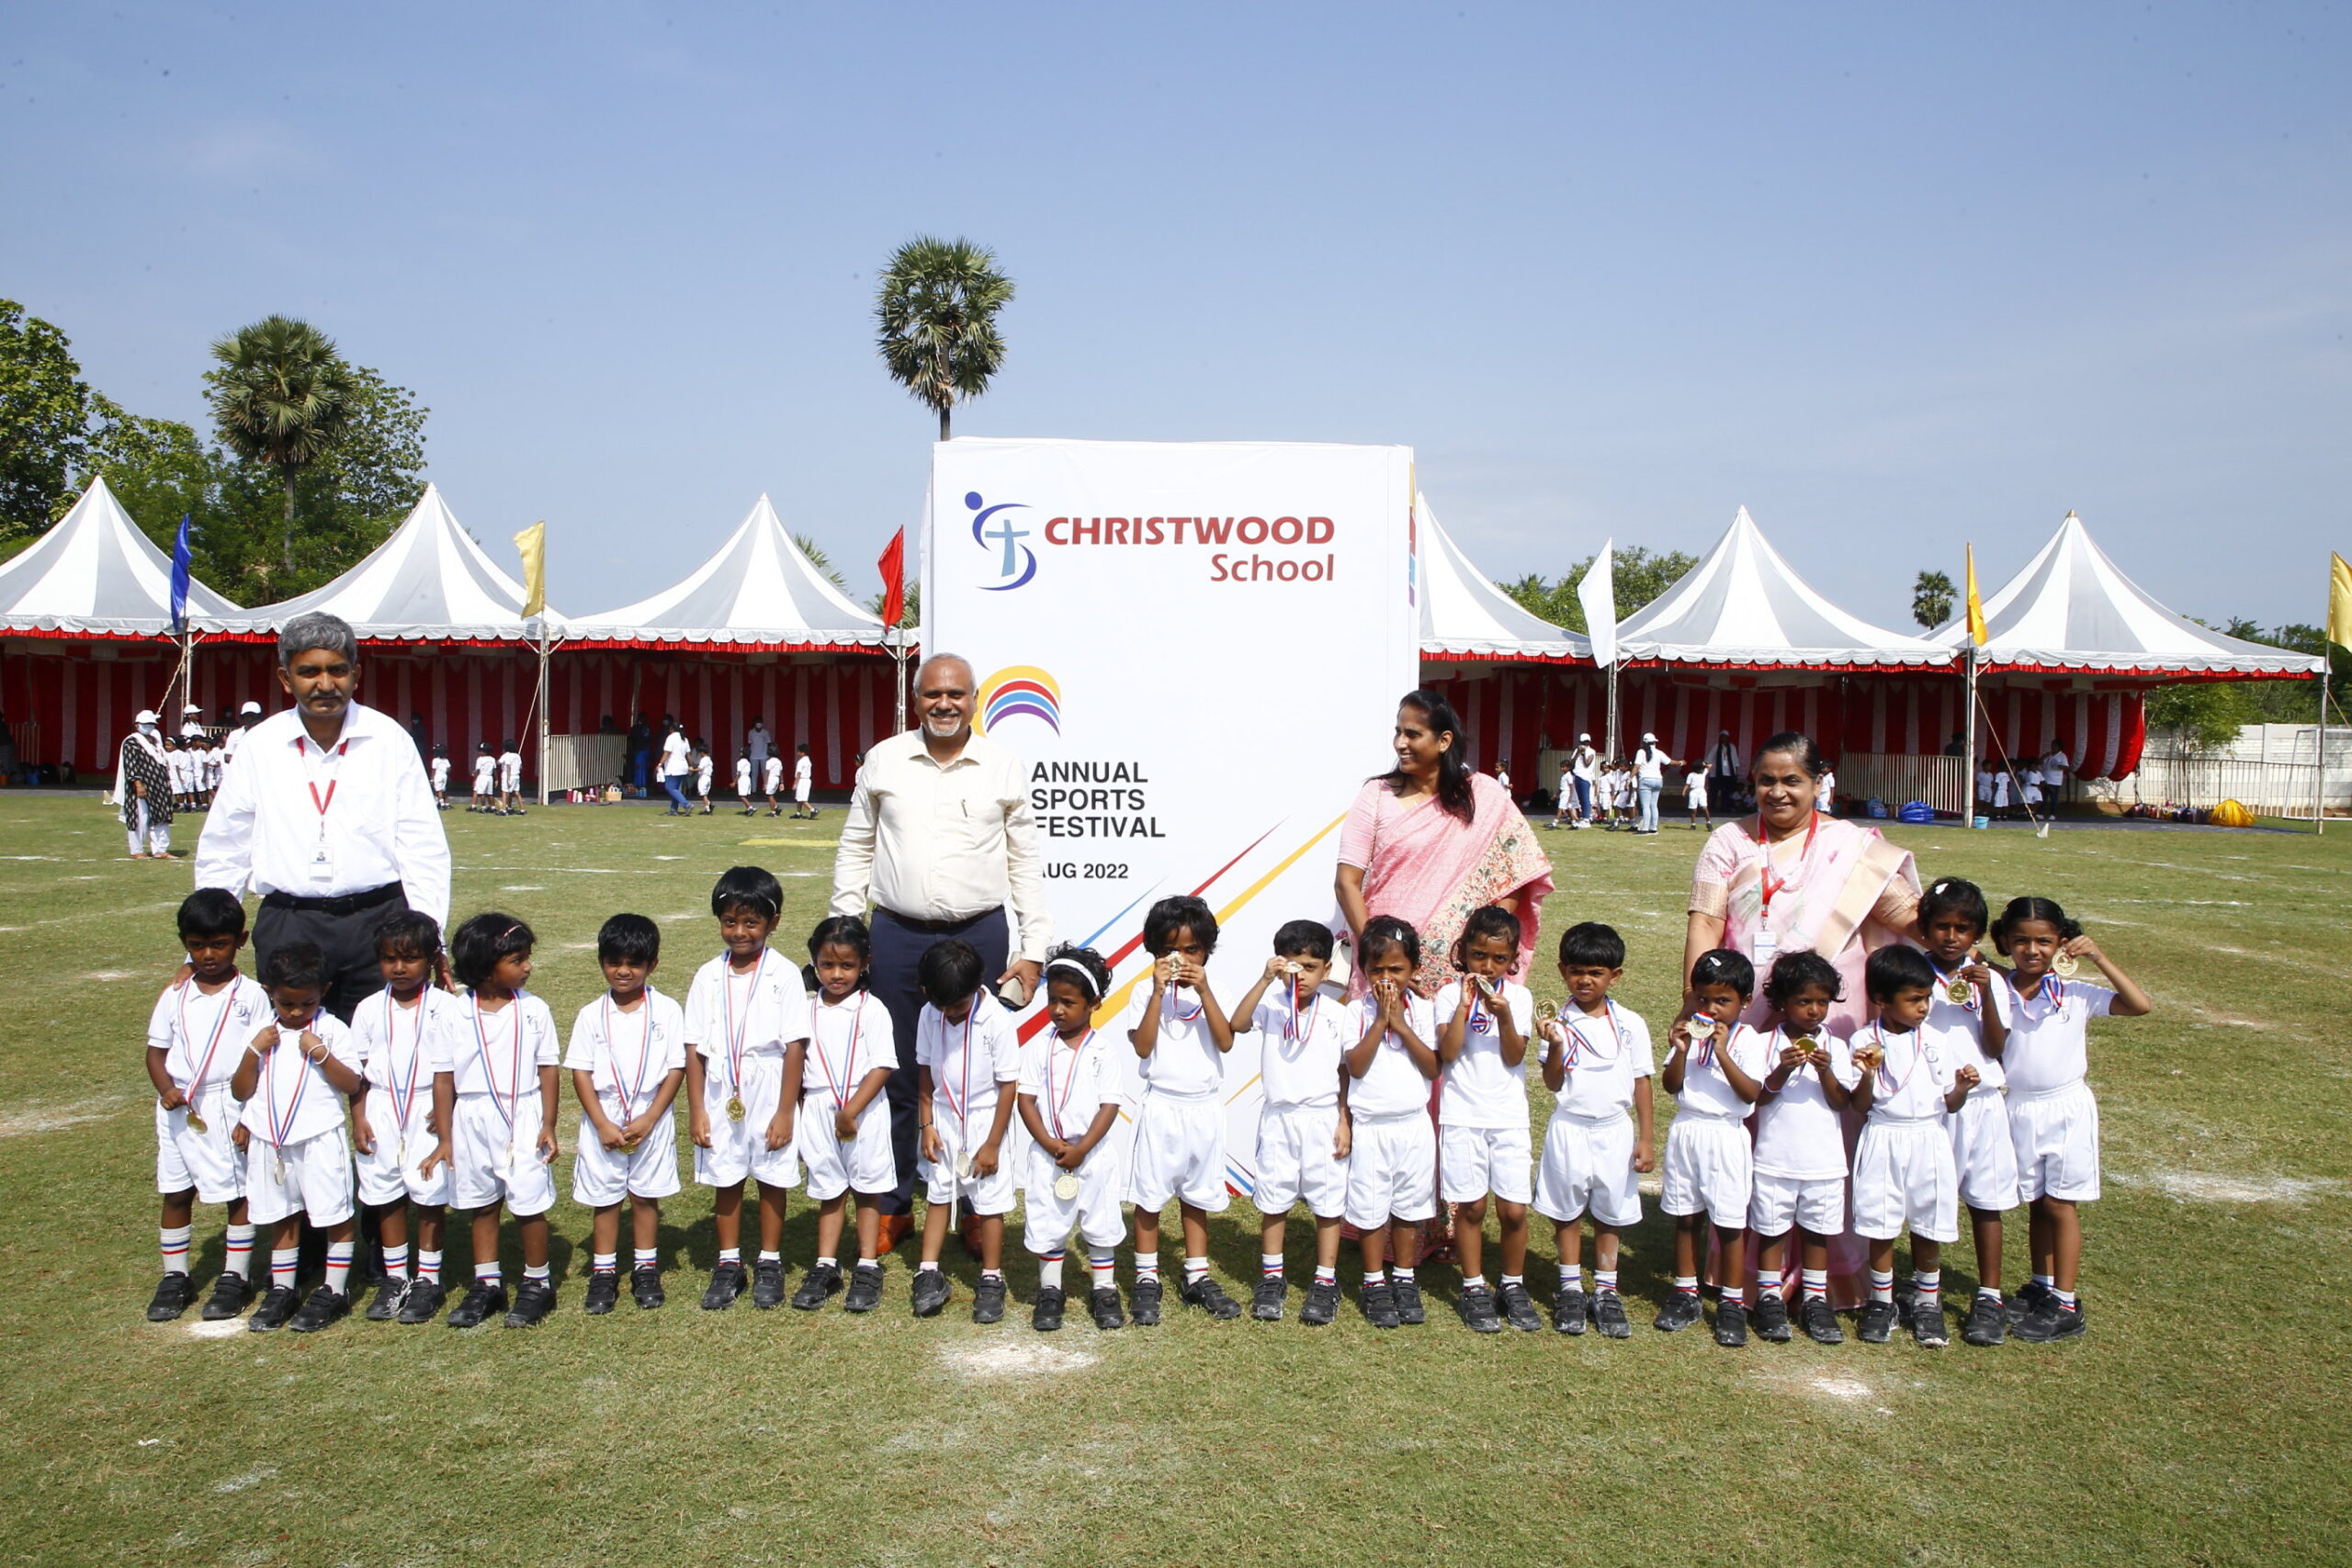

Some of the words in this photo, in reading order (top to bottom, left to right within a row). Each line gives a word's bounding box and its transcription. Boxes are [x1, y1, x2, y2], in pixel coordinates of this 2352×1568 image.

[1045, 516, 1335, 546] CHRISTWOOD
[1210, 553, 1334, 582] School
[1031, 761, 1148, 784] ANNUAL
[1031, 788, 1146, 810] SPORTS
[1042, 863, 1077, 879] UG
[1083, 863, 1129, 879] 2022
